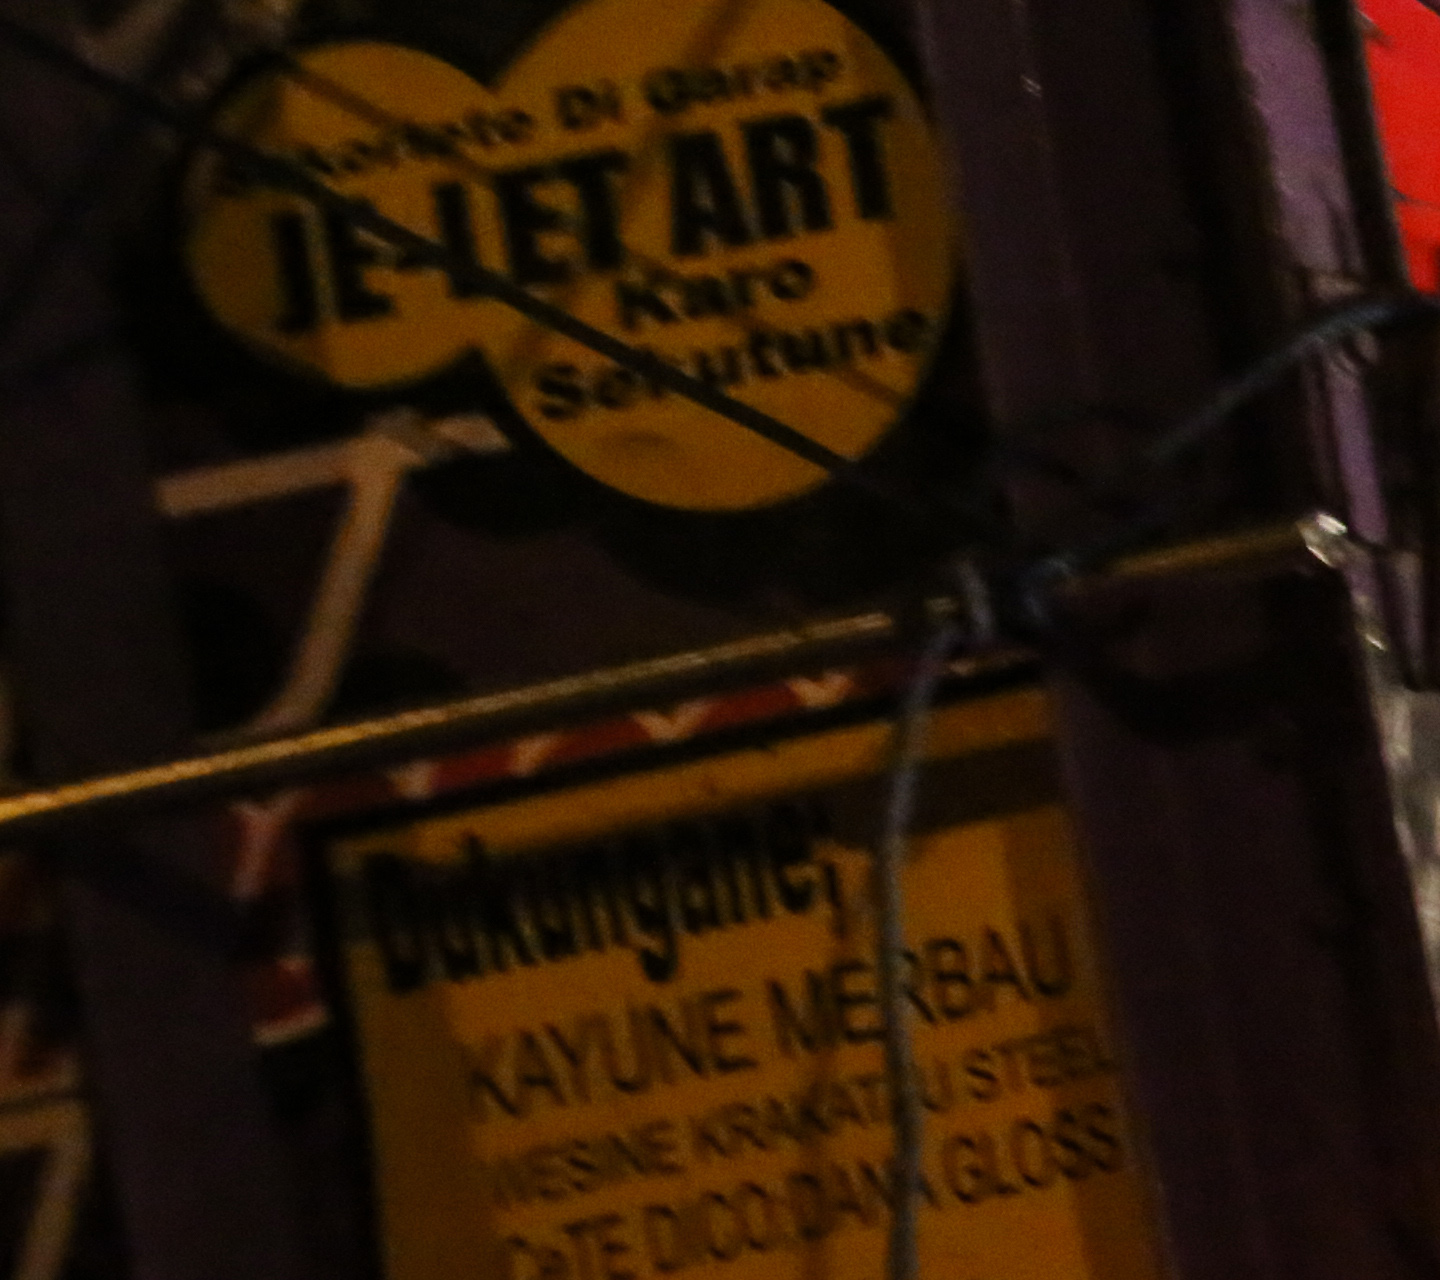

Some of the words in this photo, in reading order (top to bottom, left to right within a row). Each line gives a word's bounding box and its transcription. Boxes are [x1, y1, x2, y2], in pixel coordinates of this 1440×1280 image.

[670, 96, 897, 253] ART
[616, 258, 812, 329] Karo
[472, 990, 757, 1117] KAYUNE
[691, 1062, 952, 1159] KRAKATU
[948, 1103, 1123, 1204] GLOSS
